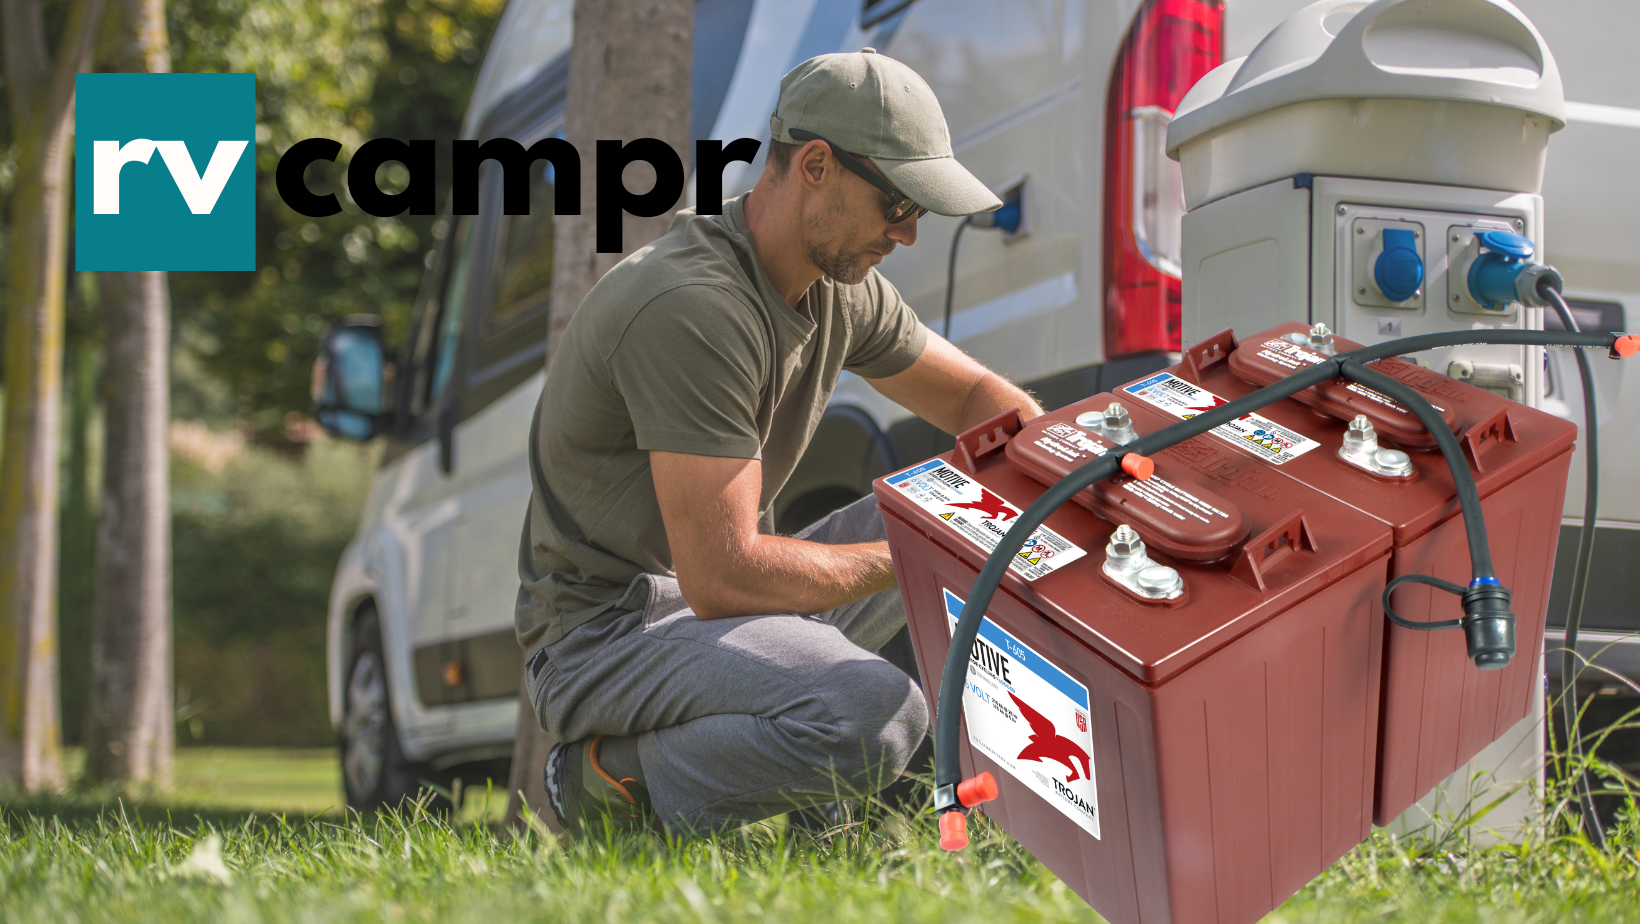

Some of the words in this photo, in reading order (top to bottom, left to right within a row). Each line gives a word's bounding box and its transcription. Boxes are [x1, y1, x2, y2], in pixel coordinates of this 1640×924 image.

[1387, 321, 1393, 333] 1
[1164, 379, 1202, 397] MOTIVE
[1224, 421, 1248, 434] ROJAN
[1065, 430, 1109, 457] Trojan
[932, 466, 971, 489] MOTIVE
[954, 622, 1012, 686] OTIVE
[1004, 638, 1026, 662] T-605
[970, 681, 990, 704] VOLT
[1052, 776, 1095, 817] TROJAN
